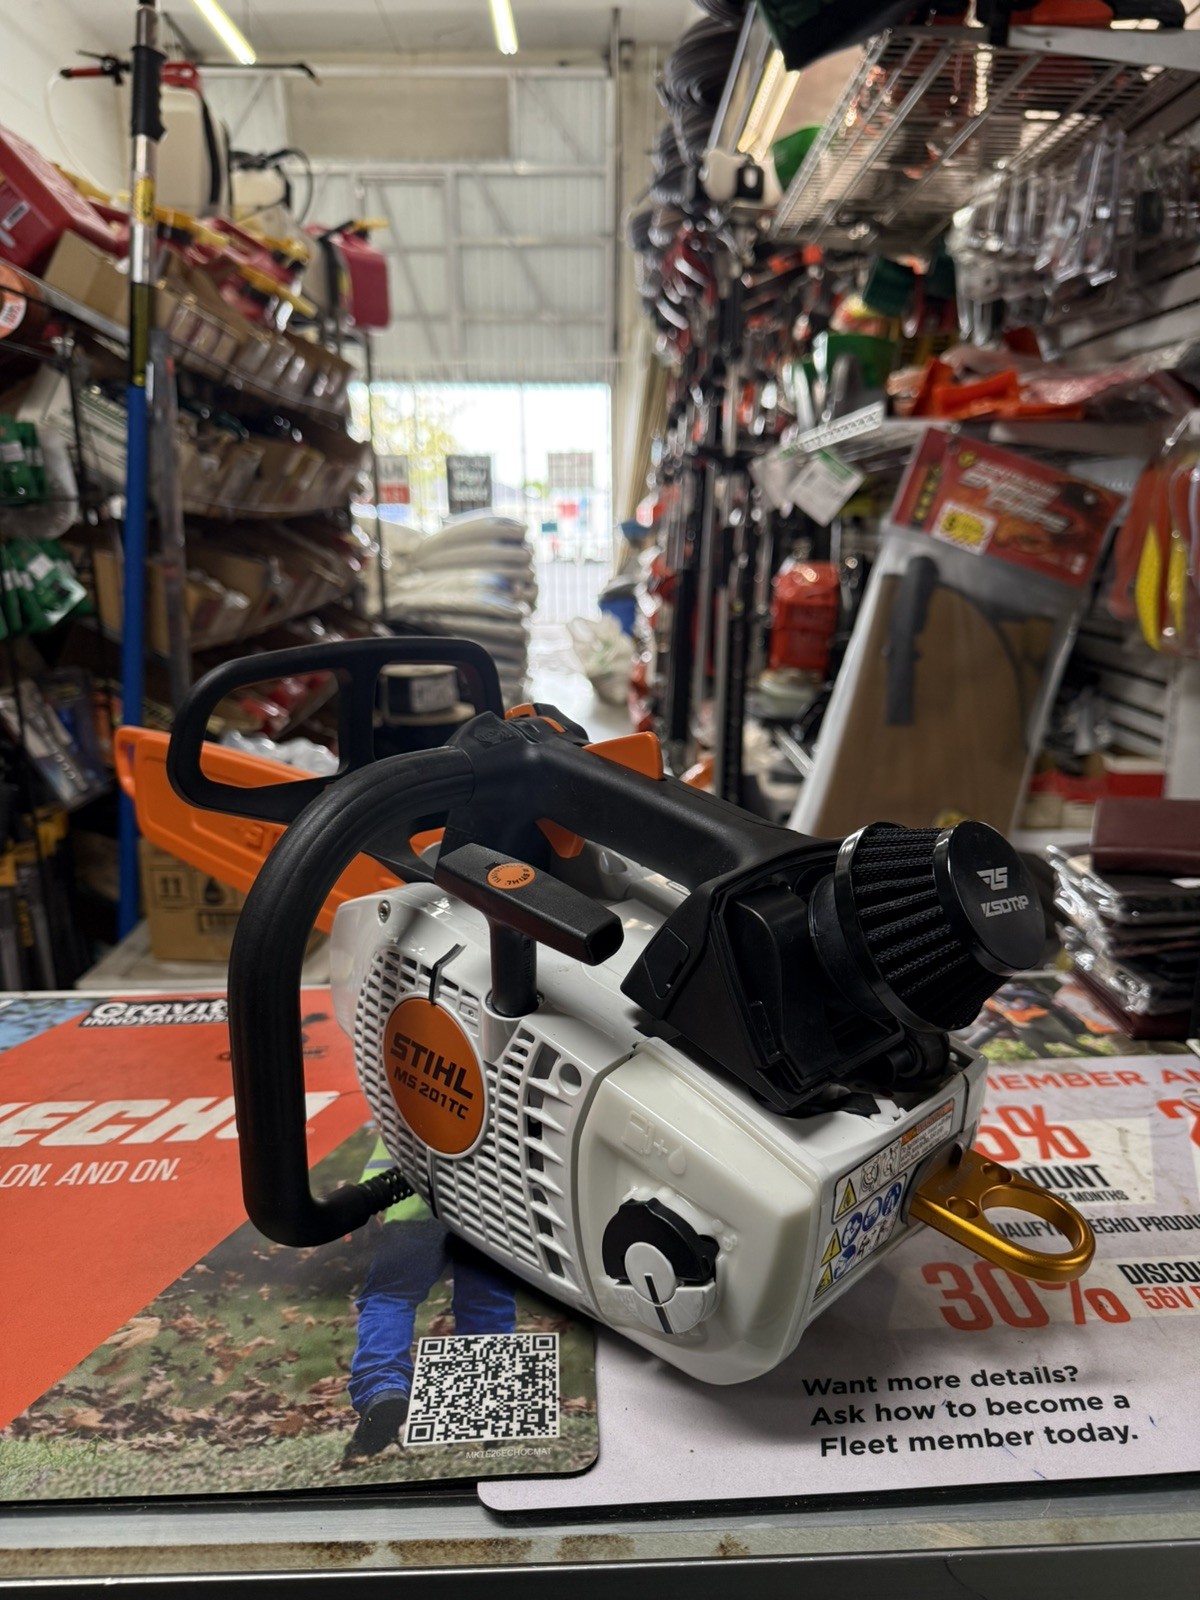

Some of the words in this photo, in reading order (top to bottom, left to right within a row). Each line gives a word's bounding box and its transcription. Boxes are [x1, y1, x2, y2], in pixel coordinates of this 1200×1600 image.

[93, 999, 228, 1017] Gravit
[390, 1032, 474, 1100] STIHL
[394, 1066, 418, 1090] MS
[419, 1082, 470, 1120] 201TC
[987, 1070, 1149, 1091] EMBER
[54, 1161, 130, 1186] AND
[129, 1158, 181, 1182] ON.
[1009, 1164, 1111, 1189] OUNT
[1069, 1190, 1129, 1202] MONTHS
[1087, 1218, 1141, 1234] ECHO
[1137, 1215, 1200, 1232] PRODU
[1135, 1286, 1194, 1310] 56V
[802, 1377, 877, 1396] Want
[887, 1371, 961, 1391] more
[970, 1365, 1079, 1387] details?
[810, 1403, 865, 1426] Ask
[875, 1403, 936, 1422] how
[946, 1400, 977, 1418] to
[985, 1394, 1104, 1416] become
[1113, 1393, 1131, 1409] a
[820, 1434, 899, 1457] Fleet
[908, 1427, 1035, 1452] member
[1043, 1422, 1140, 1445] today.
